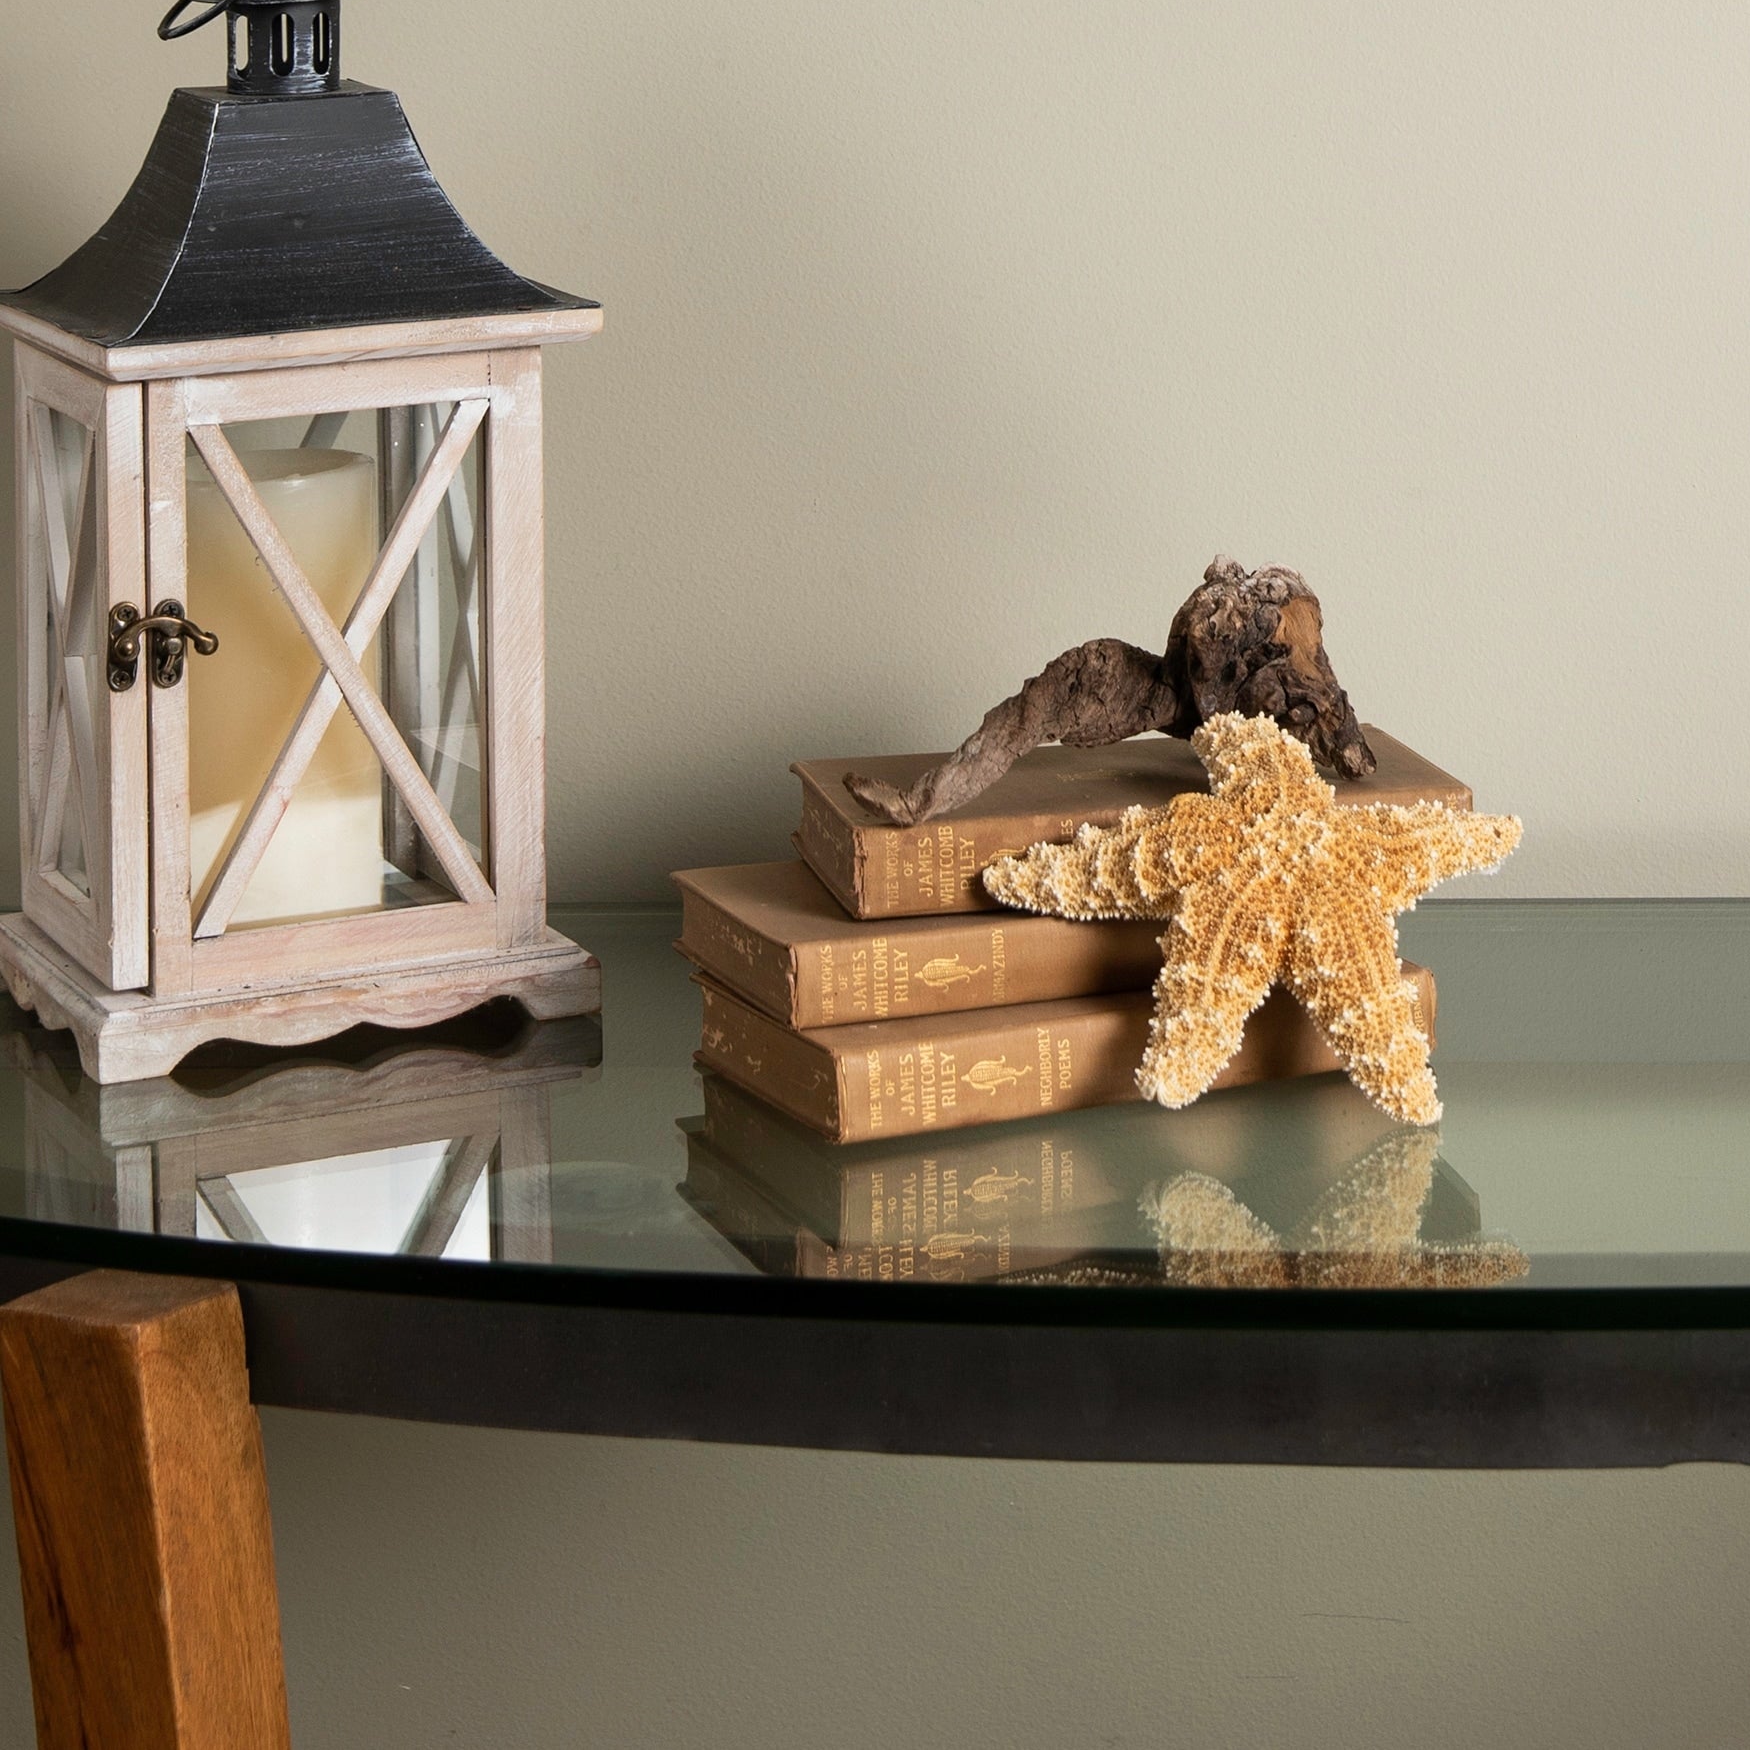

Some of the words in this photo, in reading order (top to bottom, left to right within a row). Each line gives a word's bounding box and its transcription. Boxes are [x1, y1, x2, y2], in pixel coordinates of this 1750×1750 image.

[885, 831, 900, 879] WORKS
[903, 860, 914, 877] OF
[918, 836, 933, 898] JAMES
[938, 825, 954, 907] WHITCOMB
[959, 836, 975, 891] RILEY
[886, 880, 899, 909] THE
[820, 944, 834, 994] WORKS
[838, 973, 848, 991] OF
[852, 949, 867, 1011] JAMES
[893, 947, 909, 1003] RILEY
[821, 996, 834, 1024] THE
[866, 1049, 882, 1100] WORKS
[885, 1078, 896, 1097] OF
[899, 1052, 915, 1117] JAMES
[939, 1050, 956, 1108] RILEY
[1036, 1026, 1053, 1108] NEGHBORLY
[1058, 1037, 1072, 1090] POEMS
[869, 1101, 882, 1131] THE
